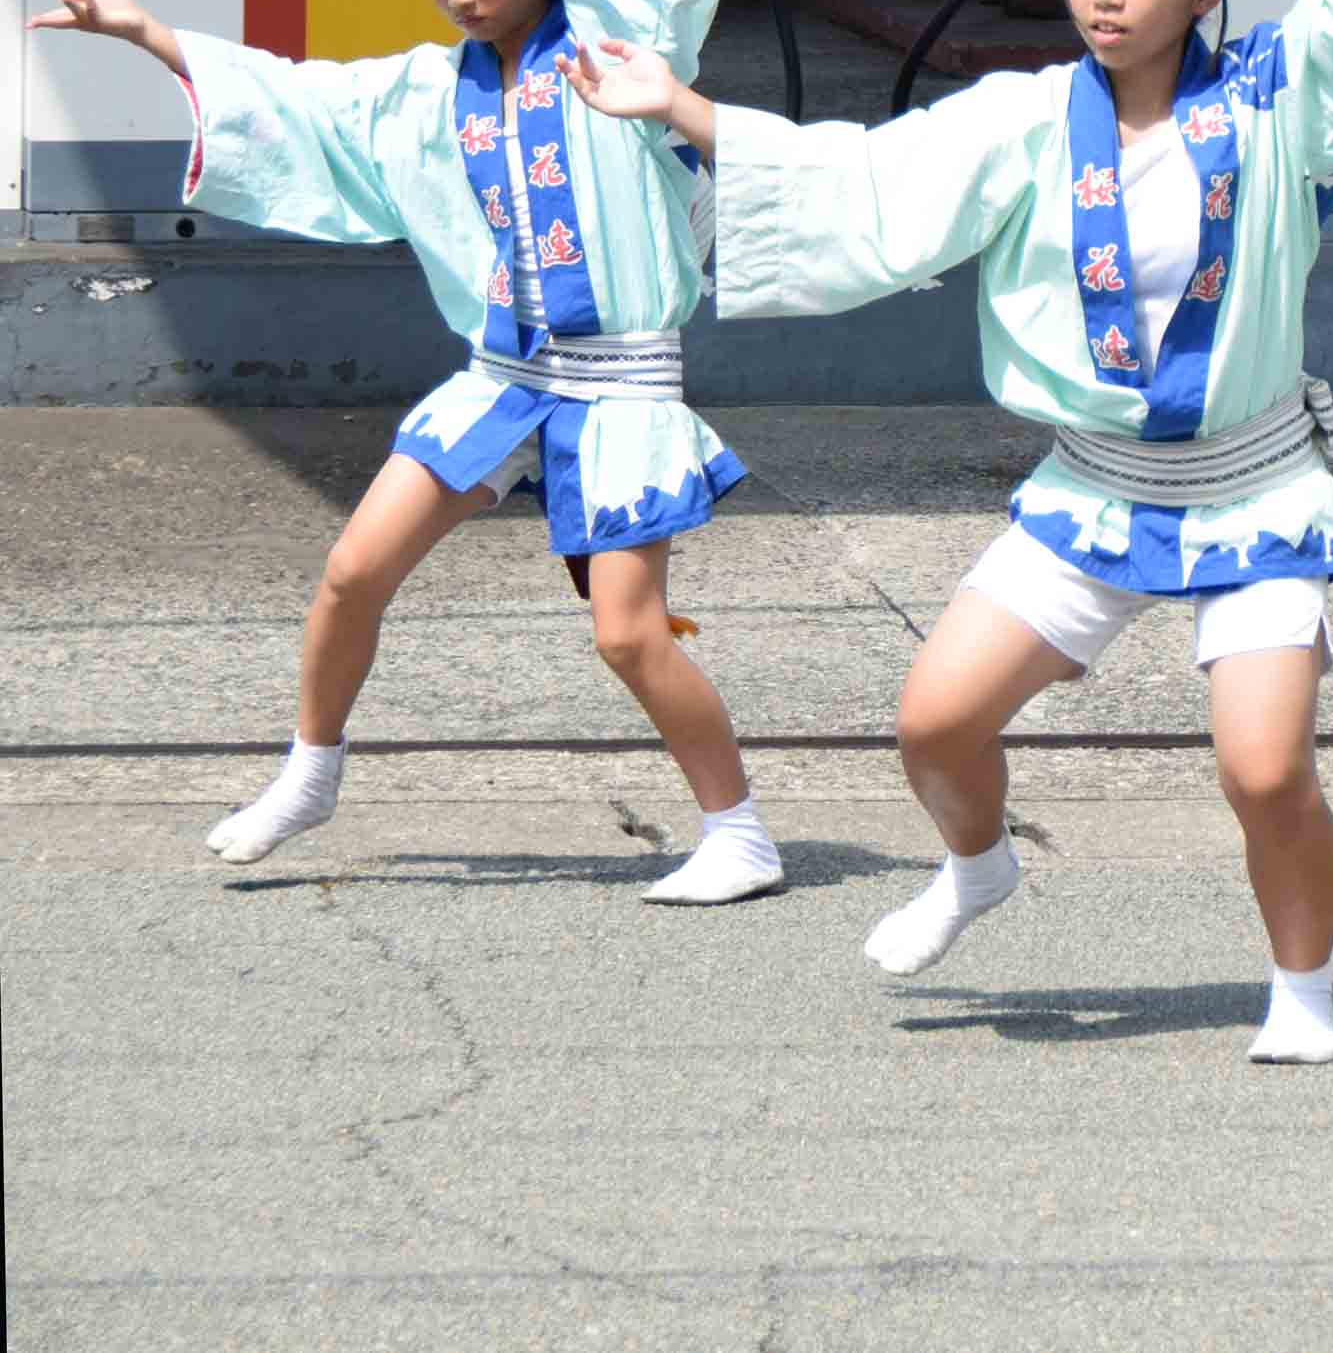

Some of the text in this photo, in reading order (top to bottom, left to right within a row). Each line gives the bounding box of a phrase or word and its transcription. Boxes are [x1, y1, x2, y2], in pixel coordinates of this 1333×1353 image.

[519, 69, 584, 270] 桜花連
[1073, 162, 1141, 372] 桜花連
